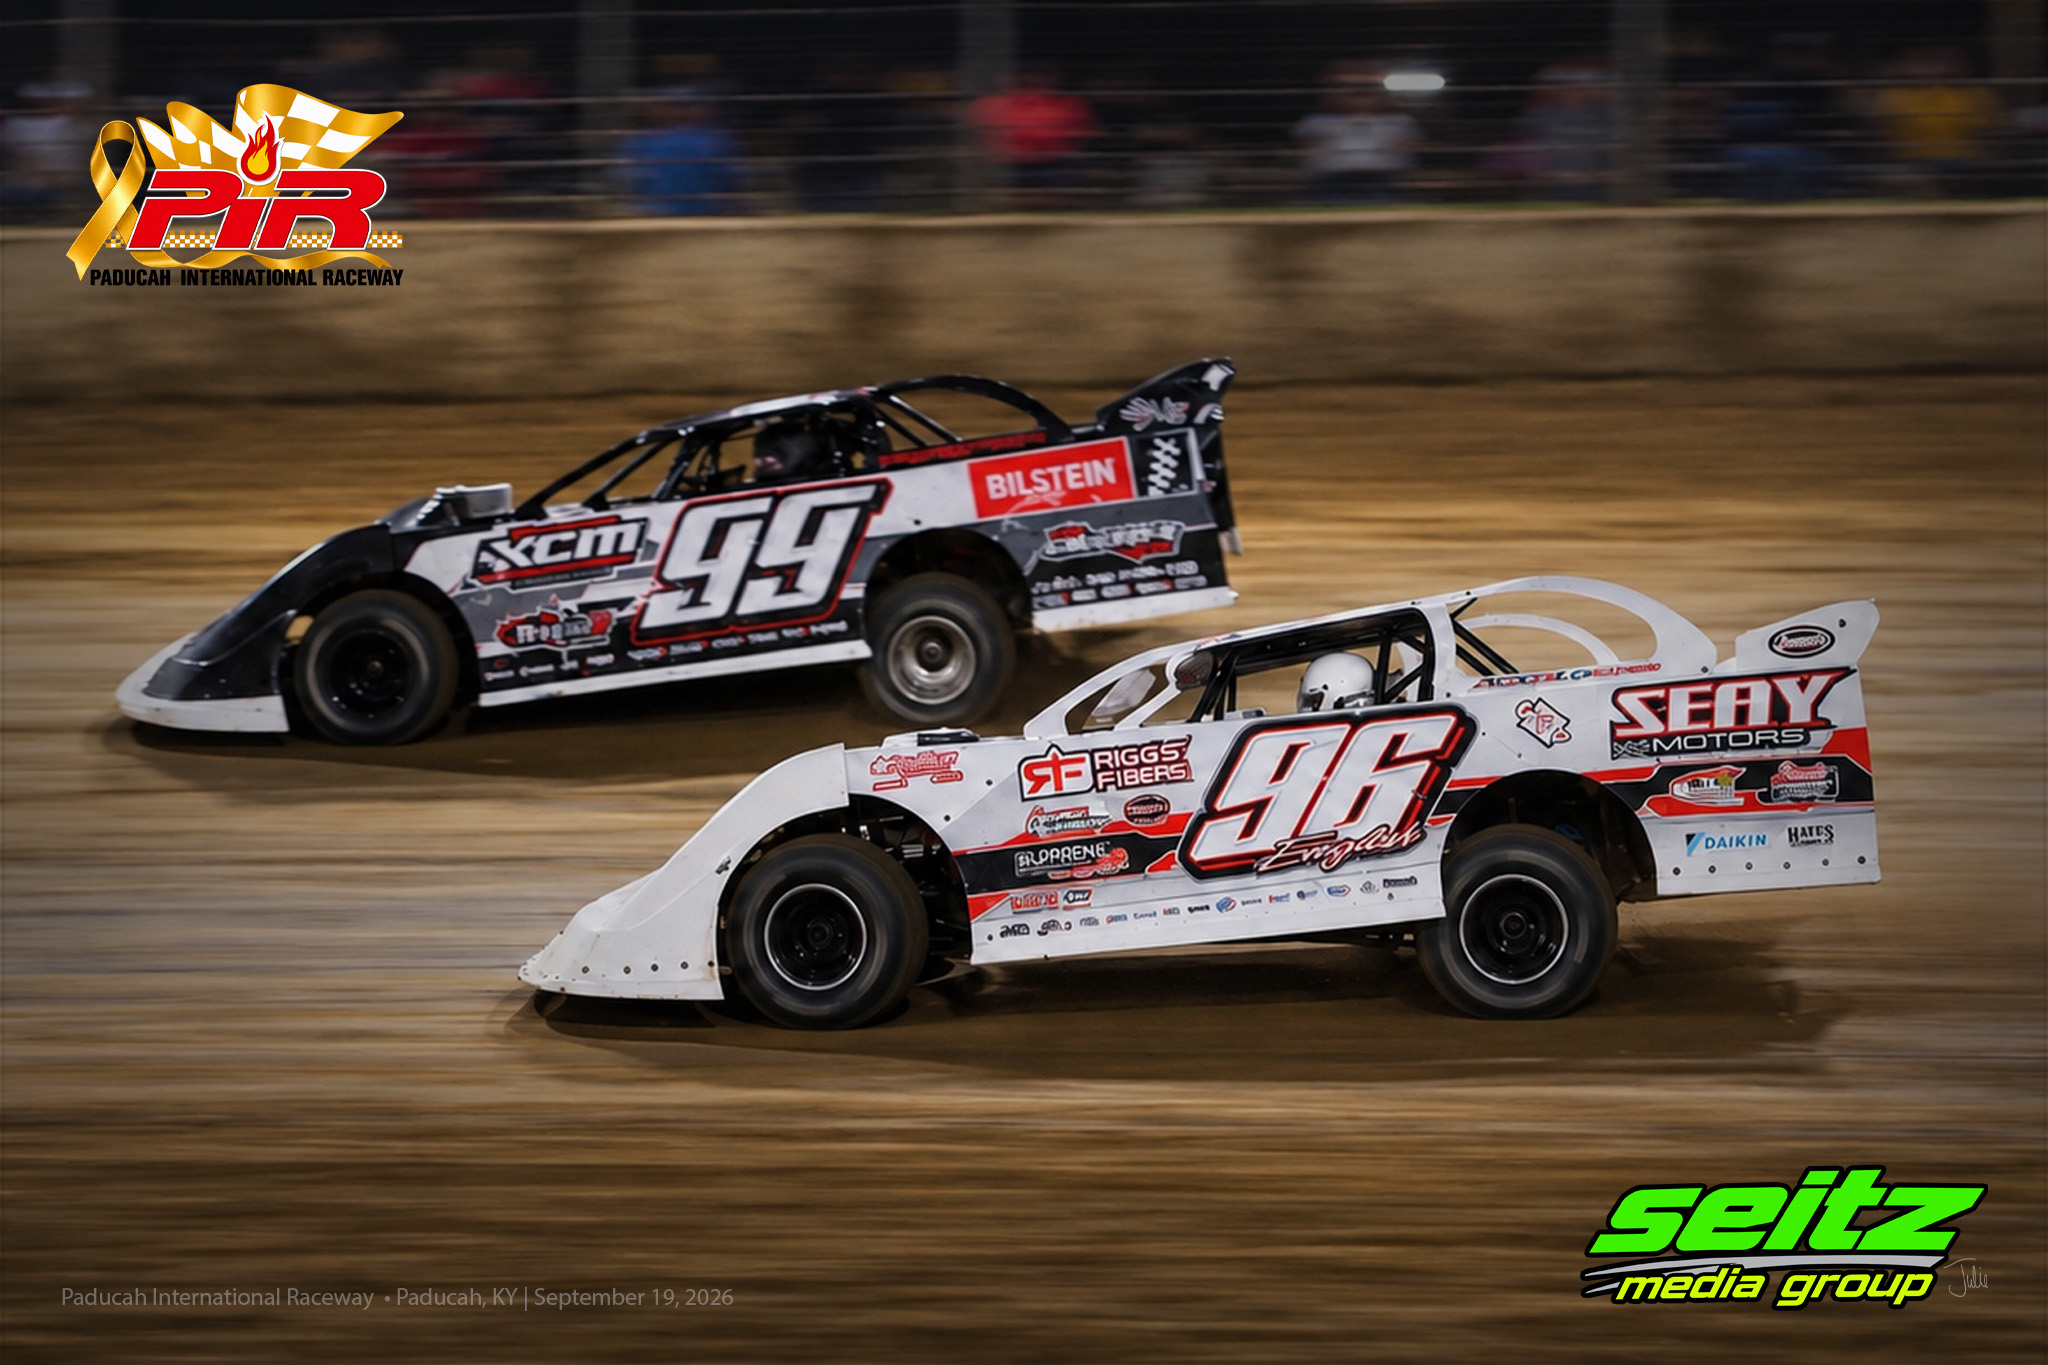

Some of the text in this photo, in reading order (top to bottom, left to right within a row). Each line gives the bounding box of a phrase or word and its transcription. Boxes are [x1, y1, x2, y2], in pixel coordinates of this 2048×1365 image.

[985, 457, 1117, 500] BILSTEIN
[637, 484, 879, 630] 99
[1615, 673, 1834, 736] SEAY
[1093, 741, 1189, 770] RIGGS
[1652, 729, 1805, 752] MOTORS
[1097, 763, 1188, 790] FIBERS
[1189, 714, 1458, 861] 96
[1704, 833, 1767, 850] DAIKIN
